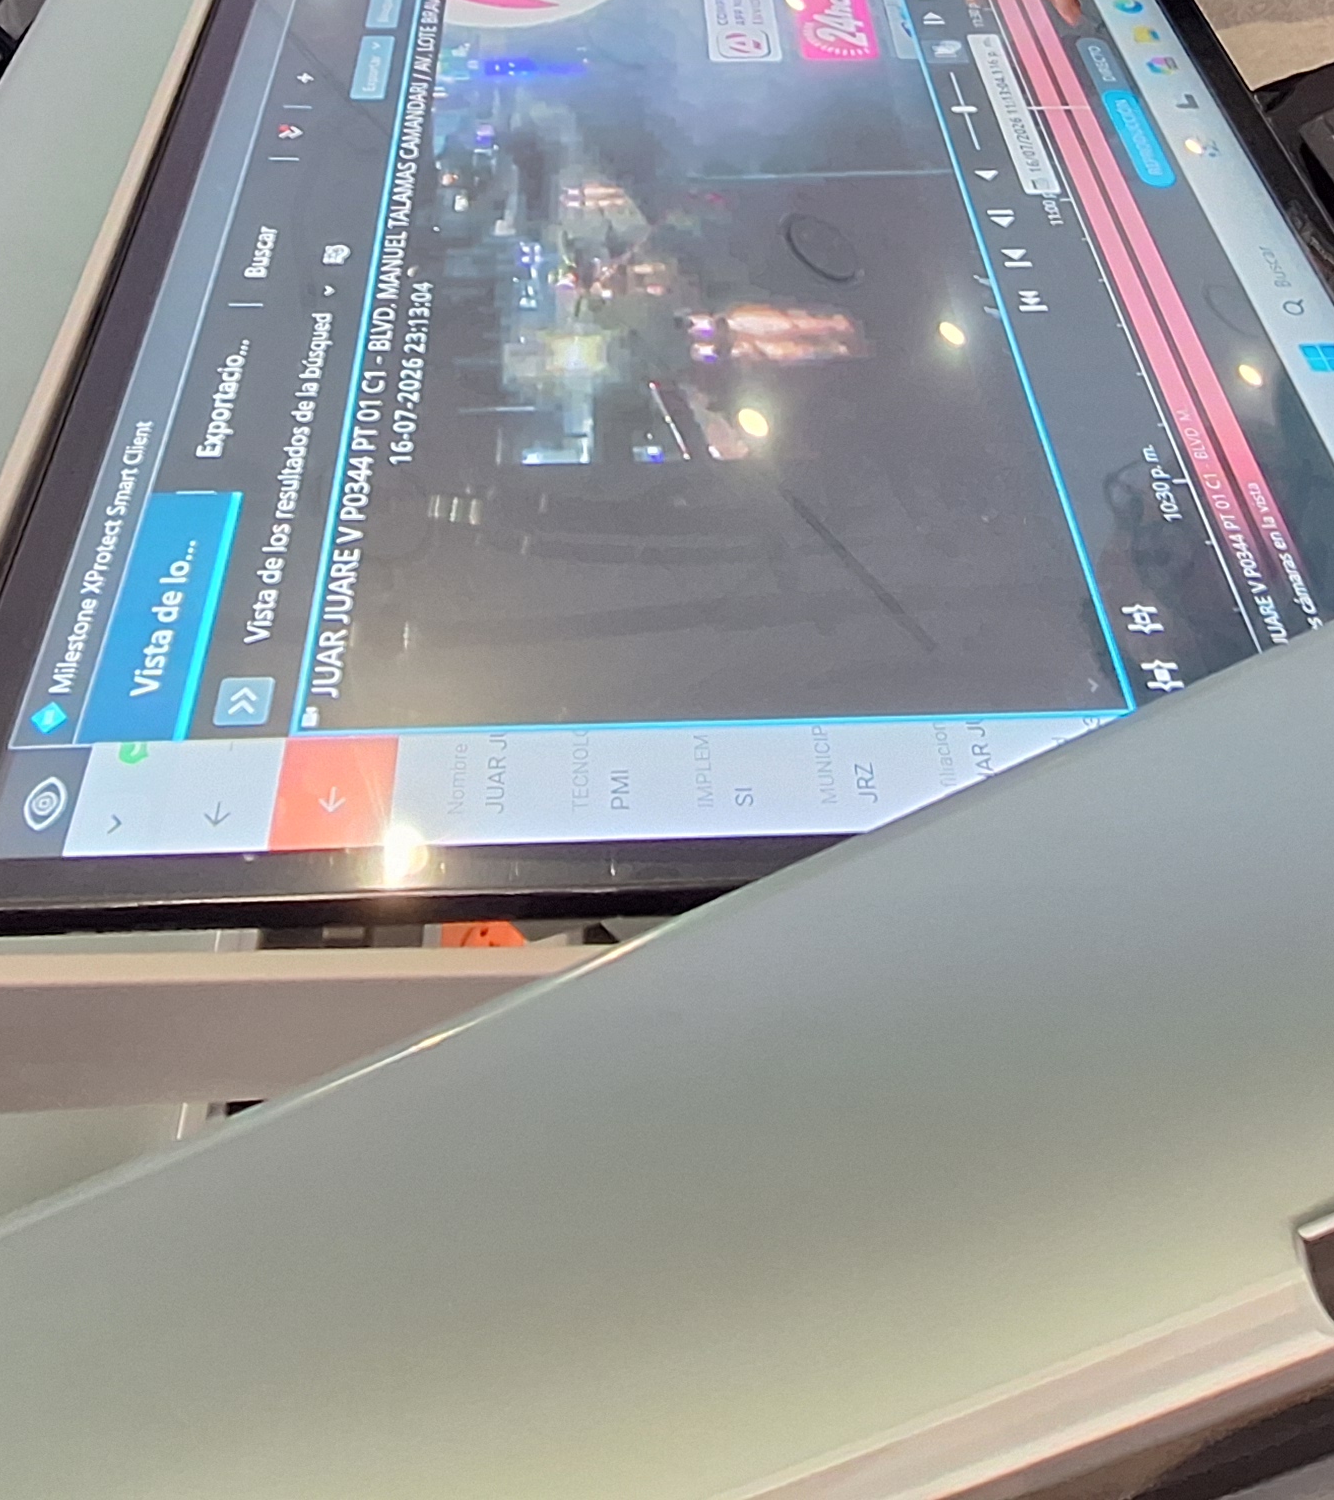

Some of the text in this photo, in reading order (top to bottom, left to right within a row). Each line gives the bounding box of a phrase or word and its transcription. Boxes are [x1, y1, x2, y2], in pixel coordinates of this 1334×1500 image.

[417, 26, 439, 50] LOTE
[1087, 44, 1116, 84] DIRECTO
[398, 82, 432, 157] CAMANDARI
[1009, 115, 1042, 173] 16/07/2026
[386, 162, 419, 228] TALAMAS
[1042, 198, 1064, 225] 11:00
[243, 228, 279, 277] Buscar
[376, 231, 410, 298] MANUEL
[1258, 245, 1291, 288] Buscar
[367, 303, 399, 351] BLVD.
[360, 370, 387, 393] C1
[387, 280, 436, 465] 16-07-2026 23:13:04
[195, 339, 251, 459] Exportacio...
[356, 398, 382, 422] 01
[351, 427, 378, 449] PT
[243, 313, 334, 643] Vista de los resultados de la búsqued
[340, 456, 374, 519] P0344
[1202, 472, 1222, 490] C1
[1244, 481, 1268, 514] vista
[1151, 479, 1182, 522] 10:30
[1210, 492, 1231, 509] 01
[1218, 511, 1241, 530] PT
[1259, 514, 1277, 529] la
[48, 419, 153, 695] Milestone XProtect Smart Client
[335, 527, 363, 546] V
[1228, 532, 1261, 577] P0344
[1268, 530, 1287, 551] en
[322, 547, 361, 622] JUARE
[1248, 581, 1267, 594] V
[1279, 552, 1316, 616] cámaras
[128, 539, 198, 697] Vista de lo...
[311, 629, 349, 696] JUAR
[447, 743, 468, 813] Nombre
[483, 756, 507, 812] JUAR
[609, 768, 629, 809] PMI
[694, 734, 713, 807] IMPLEM
[855, 762, 877, 802] JRZ
[734, 786, 753, 806] SI
